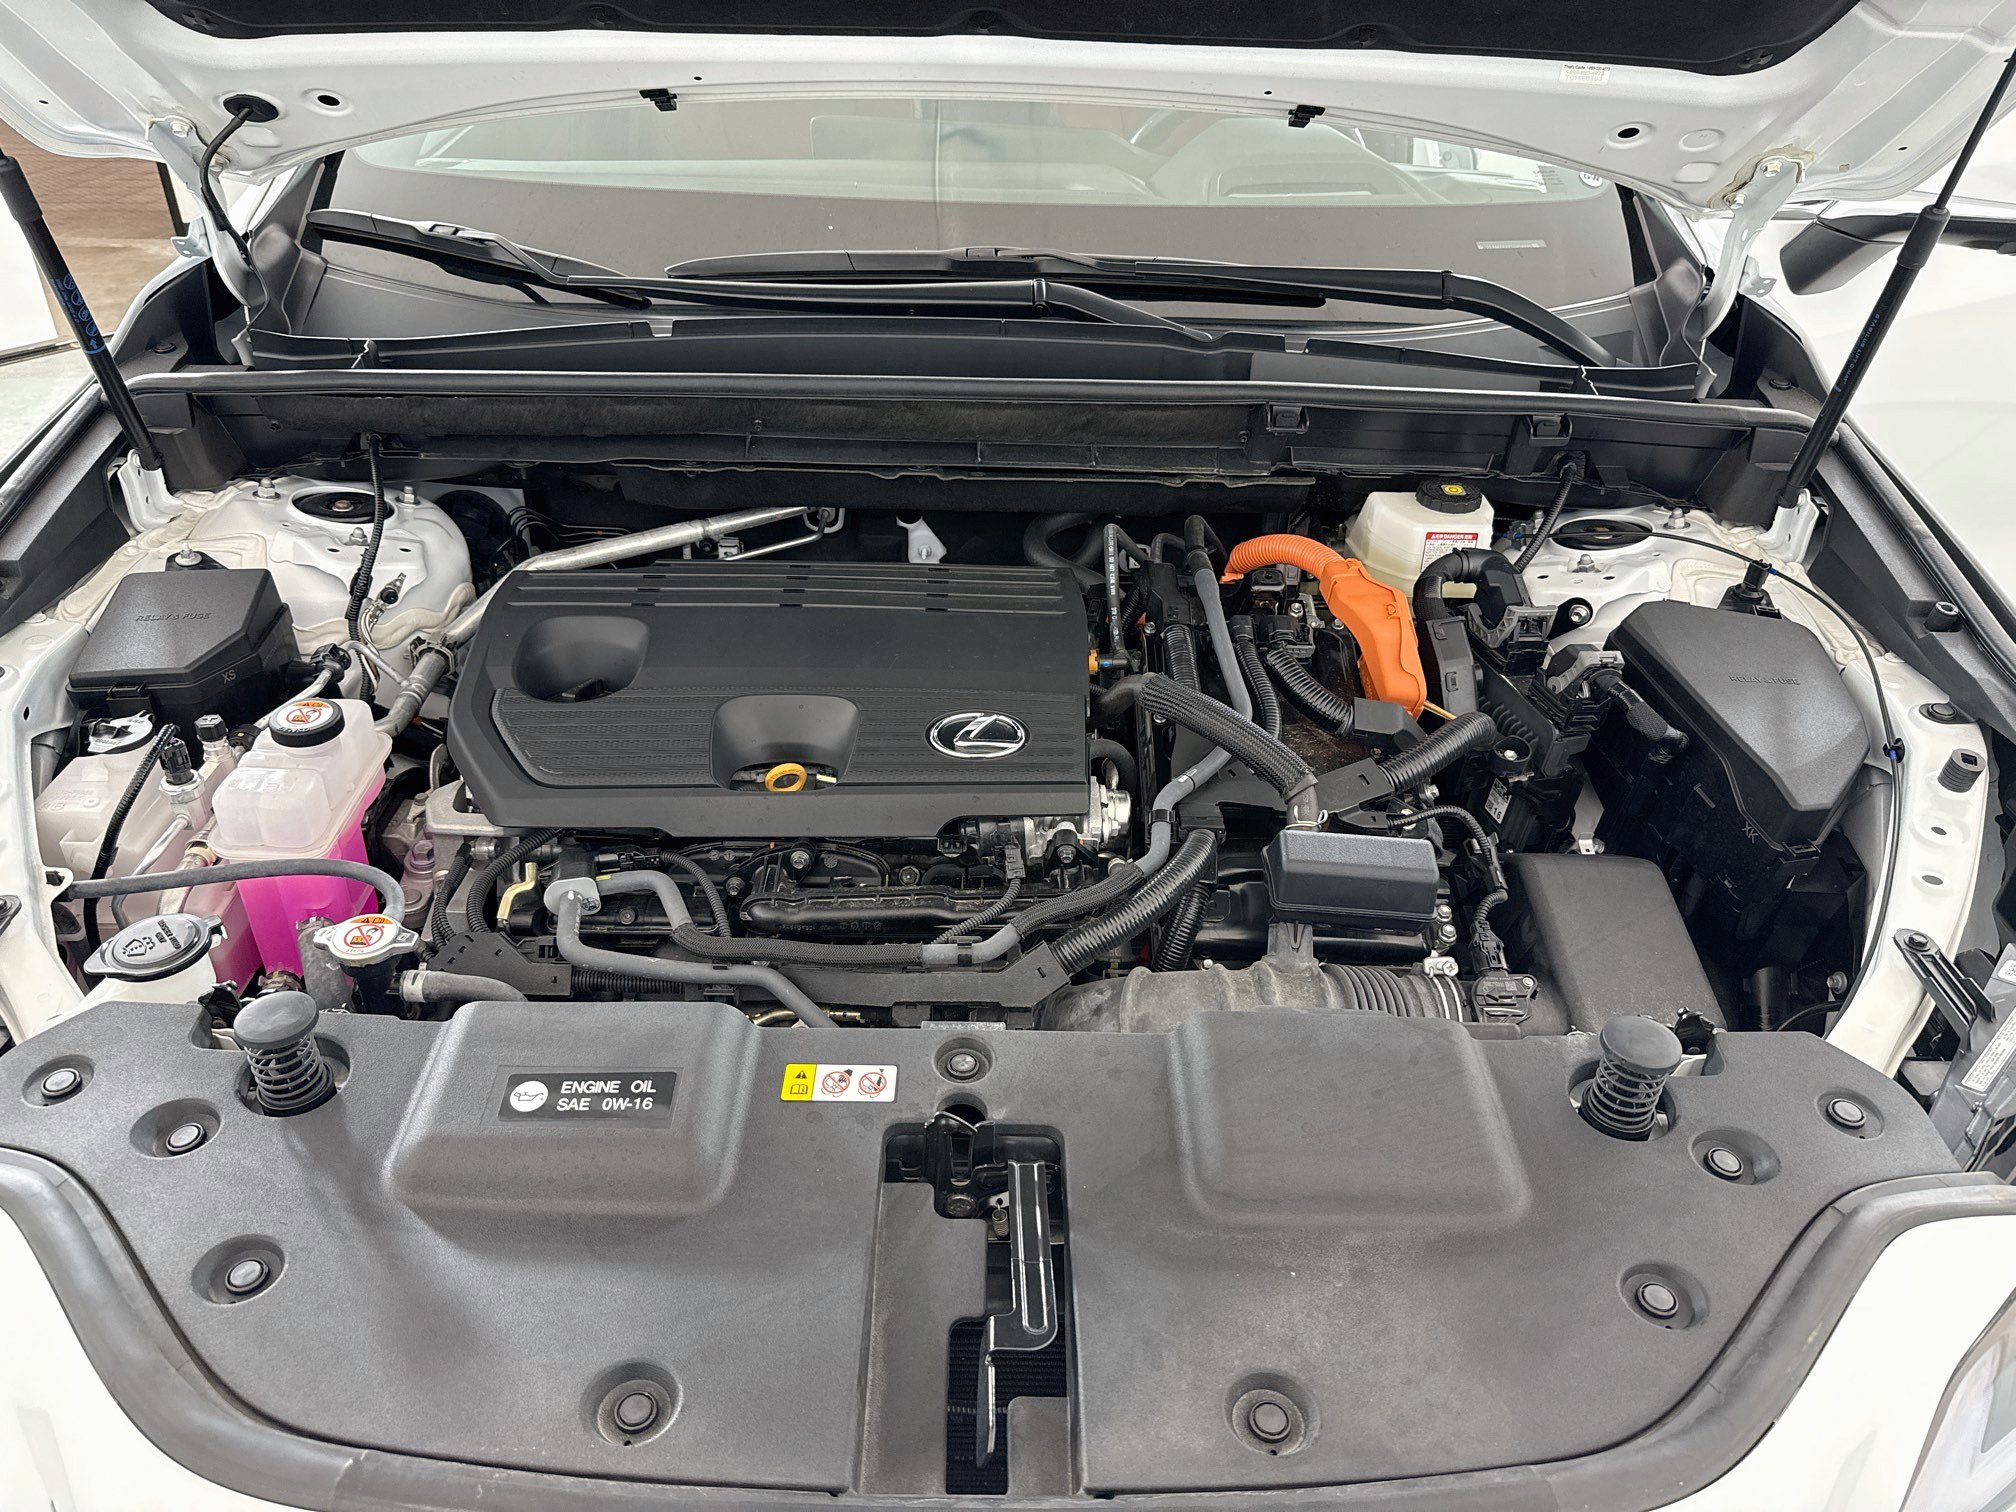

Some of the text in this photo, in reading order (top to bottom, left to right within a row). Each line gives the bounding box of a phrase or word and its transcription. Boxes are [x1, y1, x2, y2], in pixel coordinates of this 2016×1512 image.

[182, 612, 212, 620] FUSE
[221, 669, 237, 684] XS
[1741, 821, 1759, 844] XK
[560, 1080, 657, 1094] ENGINE OIL
[556, 1097, 654, 1111] SAE 0W-16
